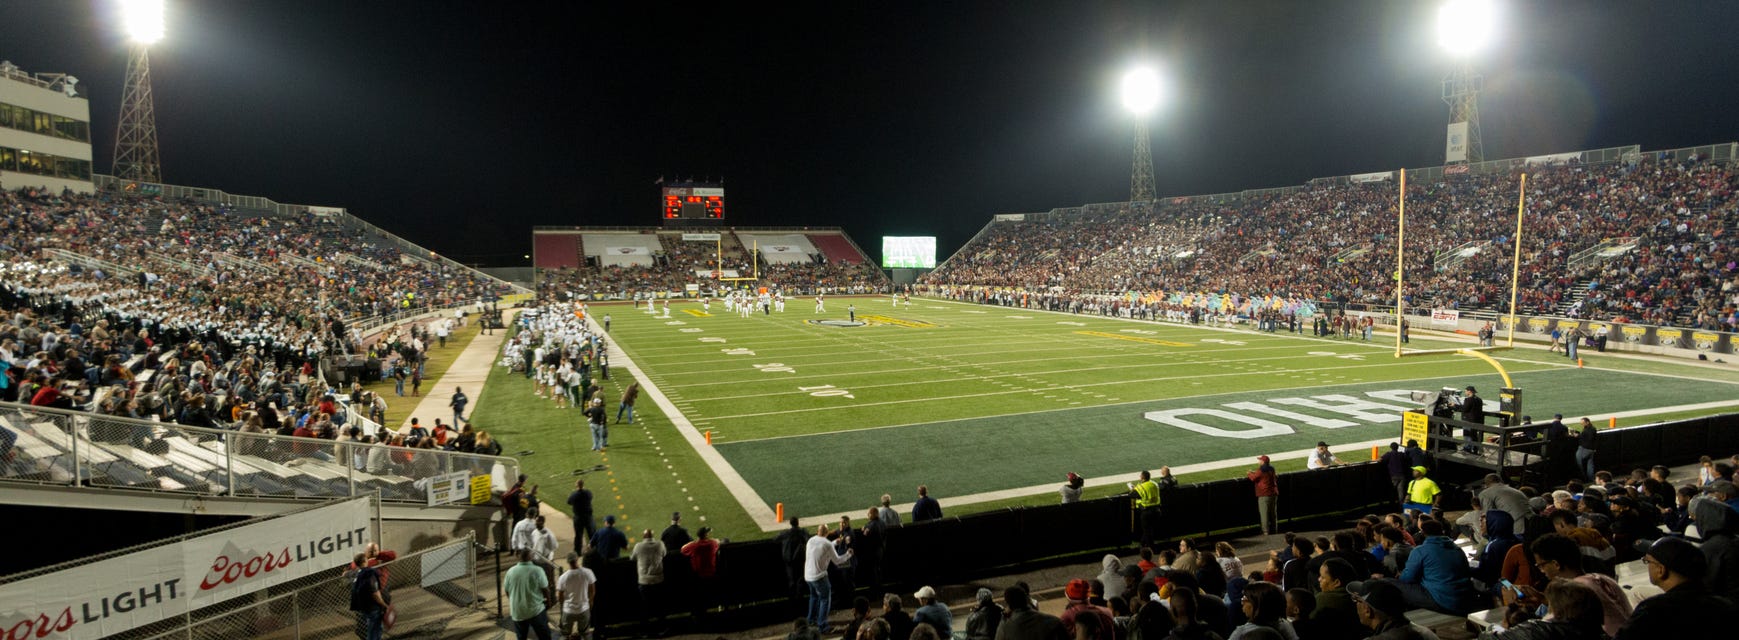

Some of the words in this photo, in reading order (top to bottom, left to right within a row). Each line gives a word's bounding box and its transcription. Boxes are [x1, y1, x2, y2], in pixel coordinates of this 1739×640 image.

[1433, 312, 1457, 321] ESPN
[798, 385, 849, 396] 10
[200, 547, 293, 590] Coors
[296, 527, 366, 563] LIGHT
[0, 606, 77, 640] ors
[82, 578, 181, 624] LIGHT
